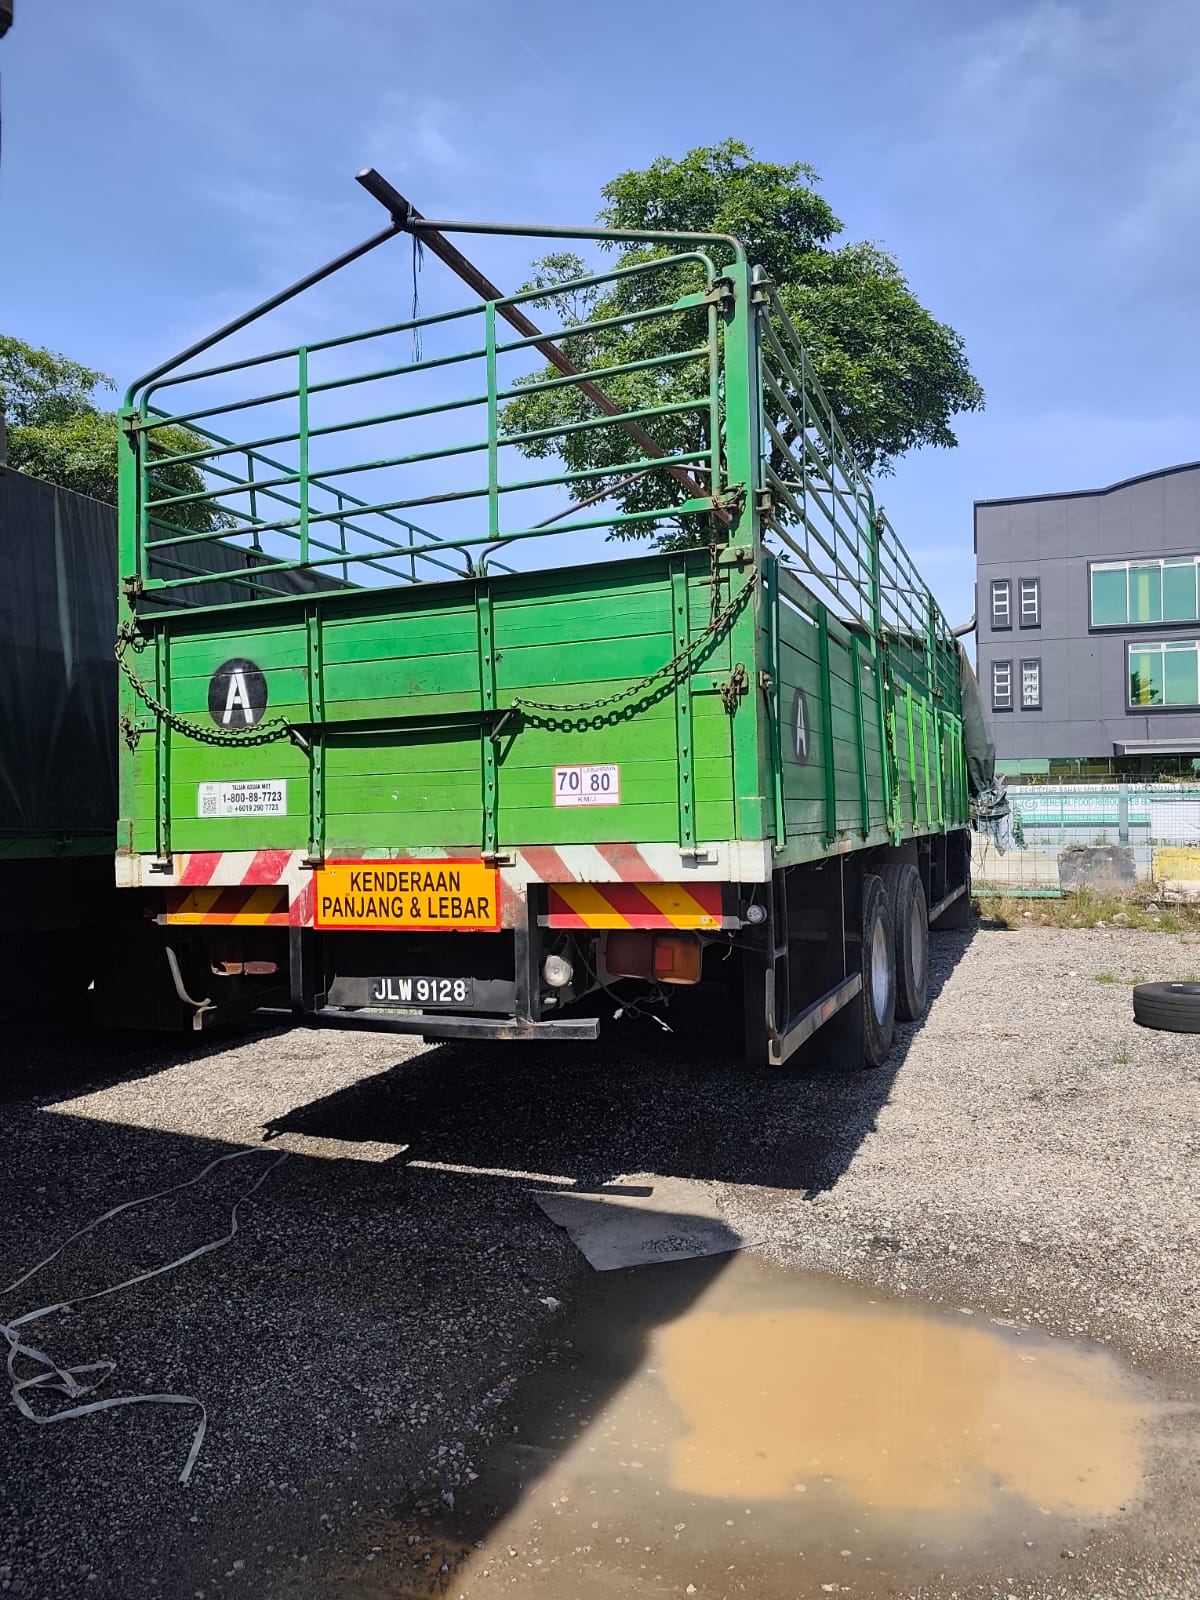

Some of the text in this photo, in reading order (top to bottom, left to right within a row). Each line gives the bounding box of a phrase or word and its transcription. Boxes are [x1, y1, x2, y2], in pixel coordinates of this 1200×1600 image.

[222, 668, 254, 724] A
[796, 697, 807, 757] A
[557, 771, 610, 791] 70 80
[222, 792, 282, 803] 1-800-88-7723
[265, 803, 279, 811] 7723
[350, 871, 460, 892] KENDERAAN
[322, 896, 490, 918] PANJANG & LEBAR
[375, 978, 466, 1002] JLW 9128
